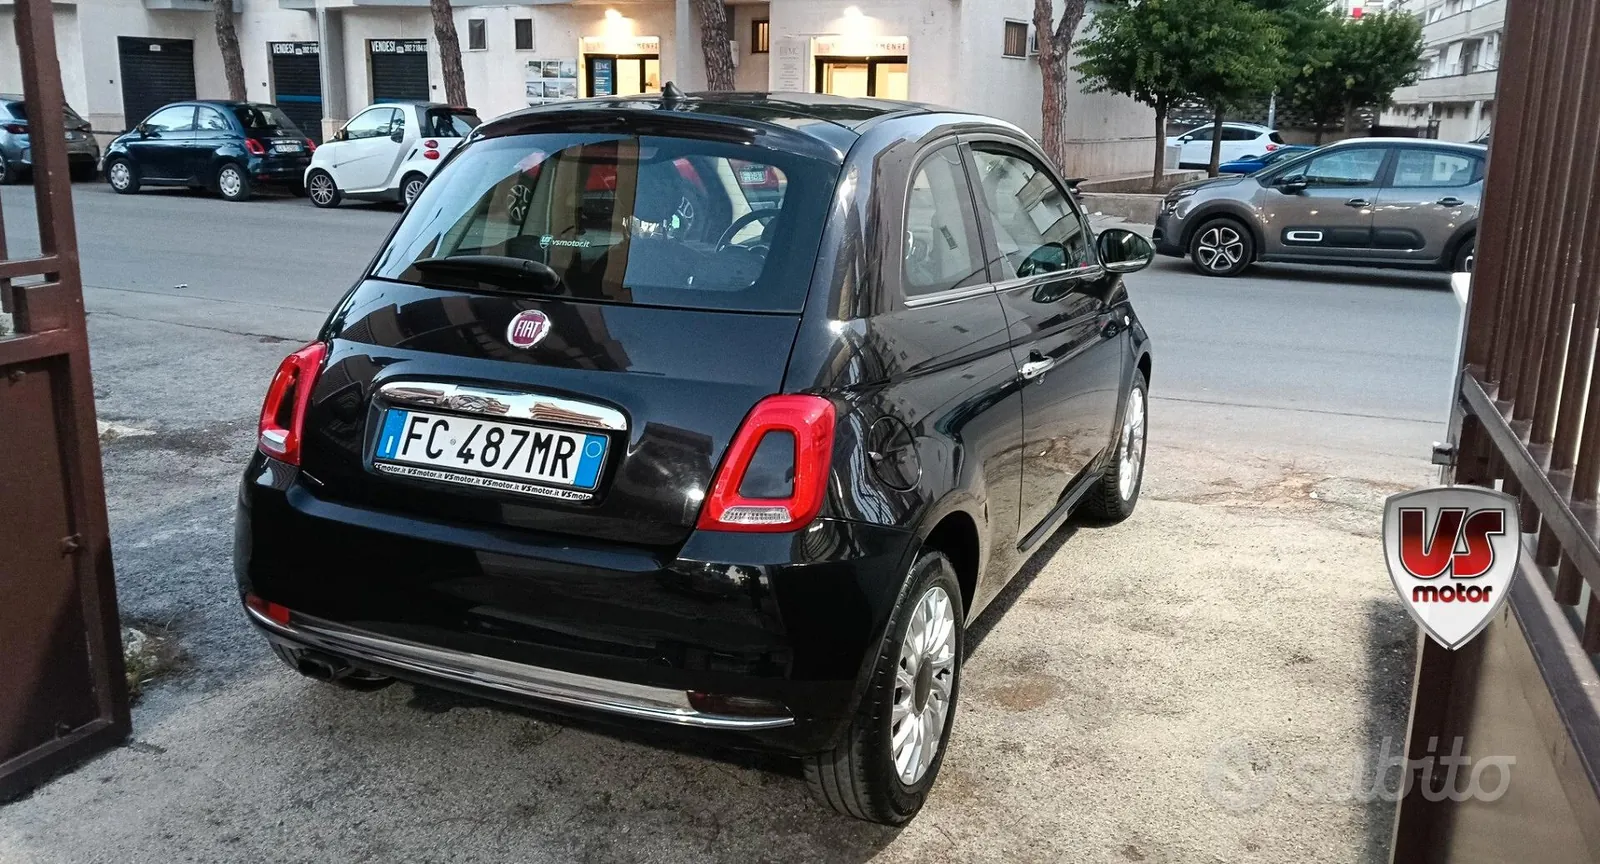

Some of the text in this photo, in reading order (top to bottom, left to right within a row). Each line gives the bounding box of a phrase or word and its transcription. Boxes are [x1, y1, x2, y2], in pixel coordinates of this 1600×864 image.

[272, 43, 295, 54] VENDESI
[370, 41, 396, 52] VENDESI
[552, 239, 590, 248] vsmotor.it
[514, 320, 542, 338] FIAT
[401, 415, 577, 479] FC 487MR
[407, 468, 443, 479] VSmotor.it
[443, 473, 481, 484] VSmotor.it
[482, 478, 520, 490] VSmotor.it
[520, 484, 560, 497] VSmotor.it
